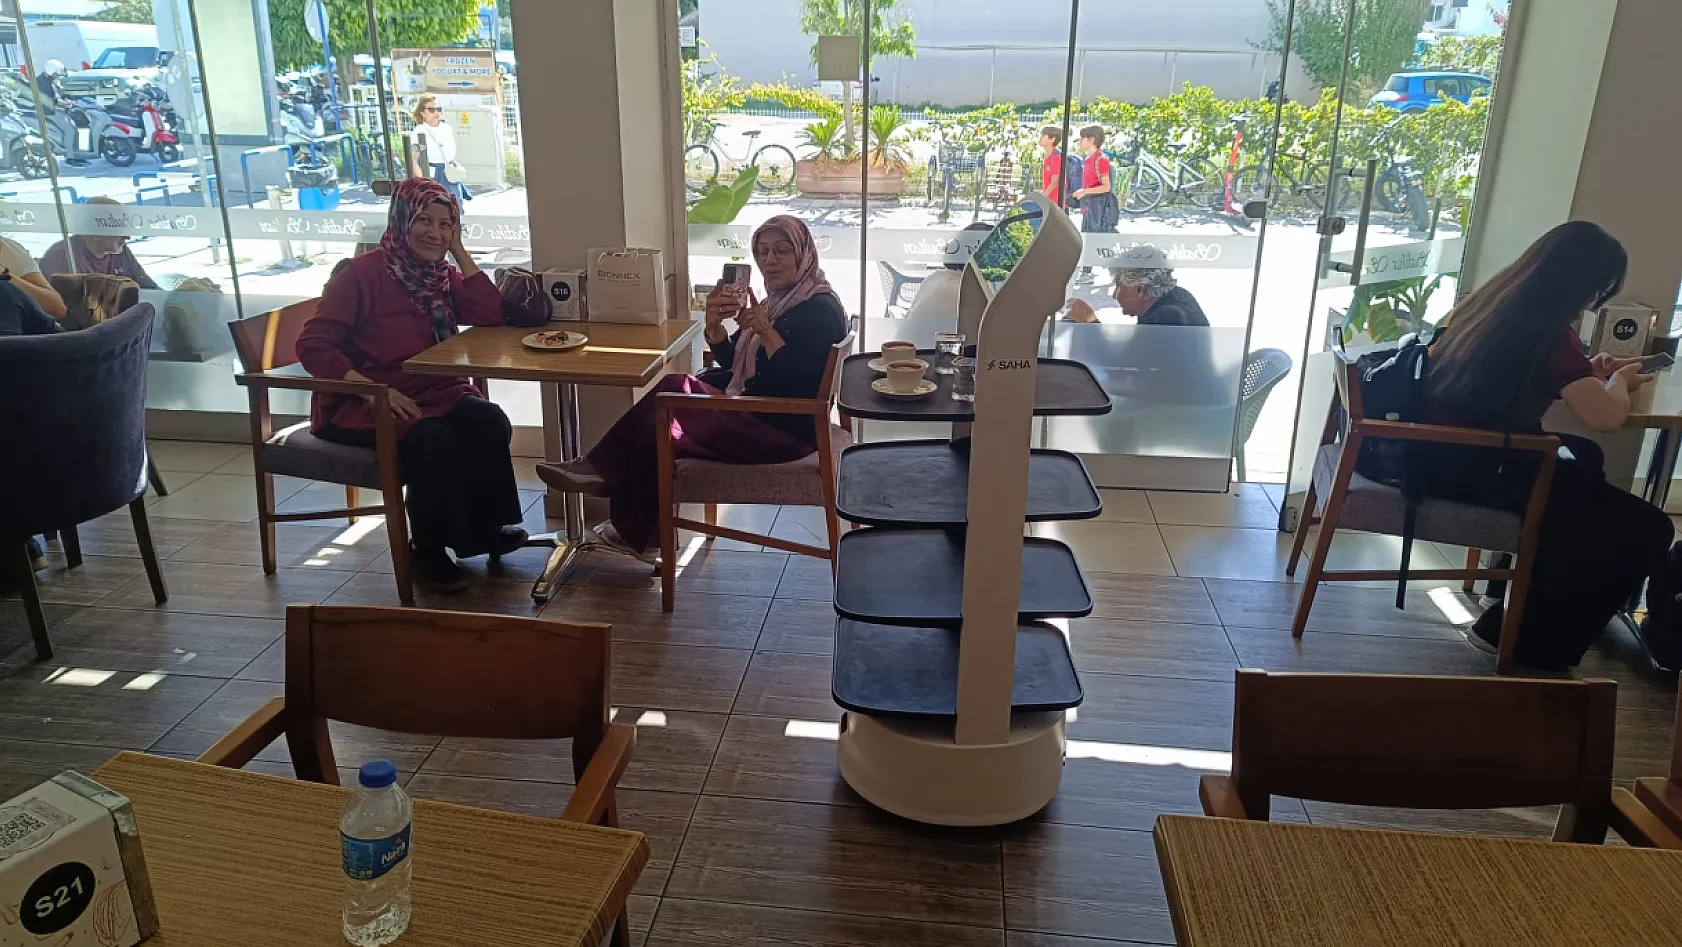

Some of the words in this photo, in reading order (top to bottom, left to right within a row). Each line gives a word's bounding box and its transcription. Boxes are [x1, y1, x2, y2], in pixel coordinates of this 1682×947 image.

[445, 57, 475, 65] FROZEN
[1616, 325, 1635, 333] S14
[999, 360, 1031, 370] SAHA
[34, 876, 84, 918] S21
